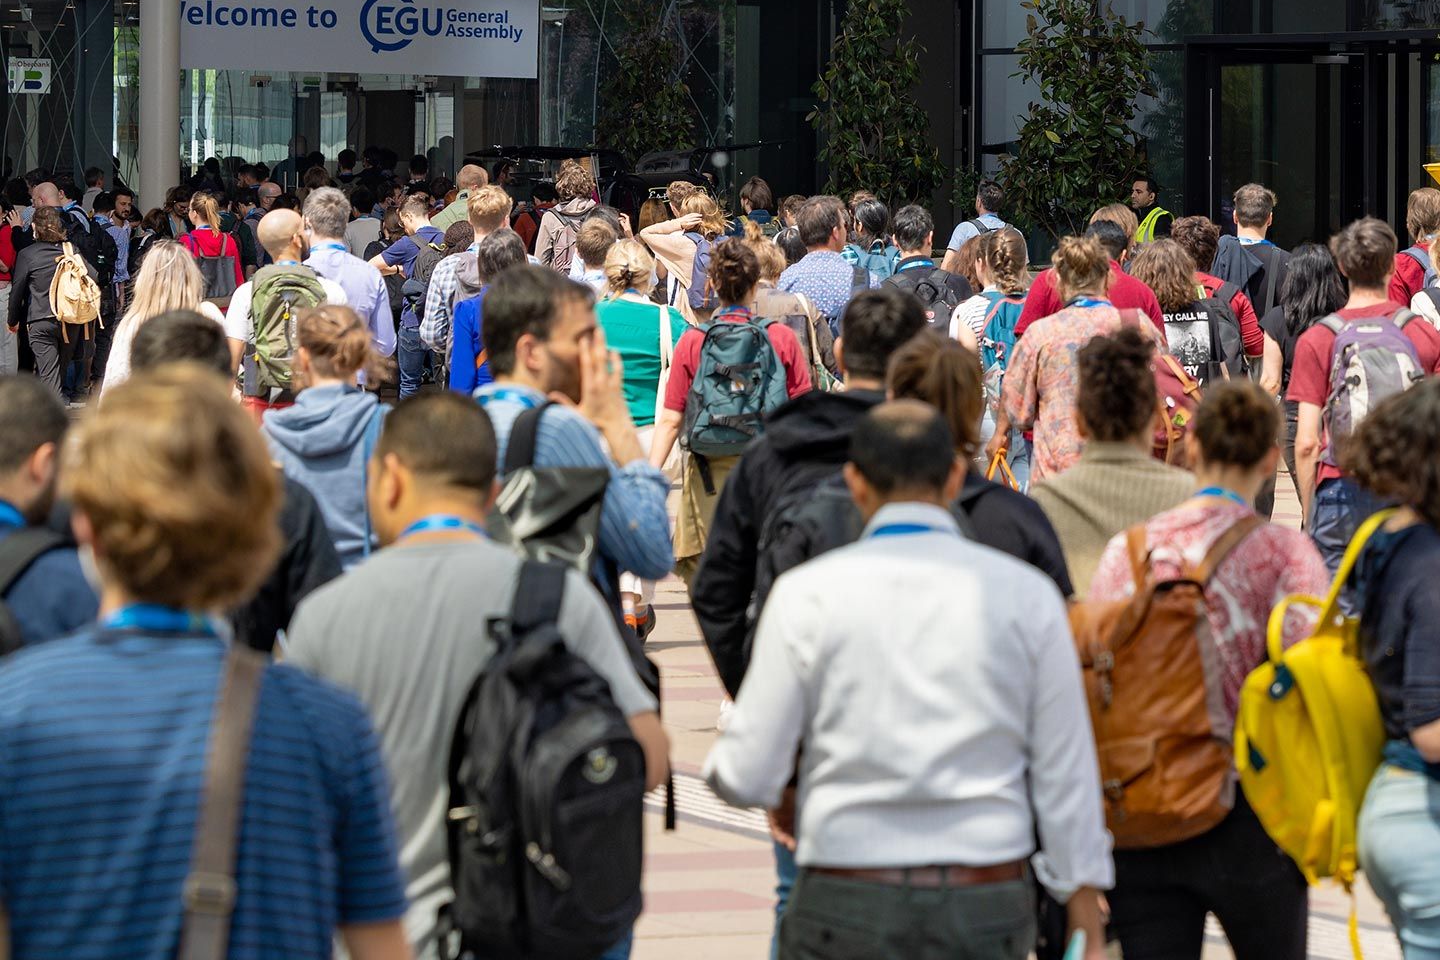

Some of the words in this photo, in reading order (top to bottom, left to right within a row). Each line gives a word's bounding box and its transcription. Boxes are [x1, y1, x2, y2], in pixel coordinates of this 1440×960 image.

[306, 6, 338, 29] to
[376, 6, 443, 36] EGU
[446, 8, 509, 24] General
[445, 24, 524, 43] Assembly
[1175, 312, 1197, 321] CALL
[1197, 312, 1208, 320] ME
